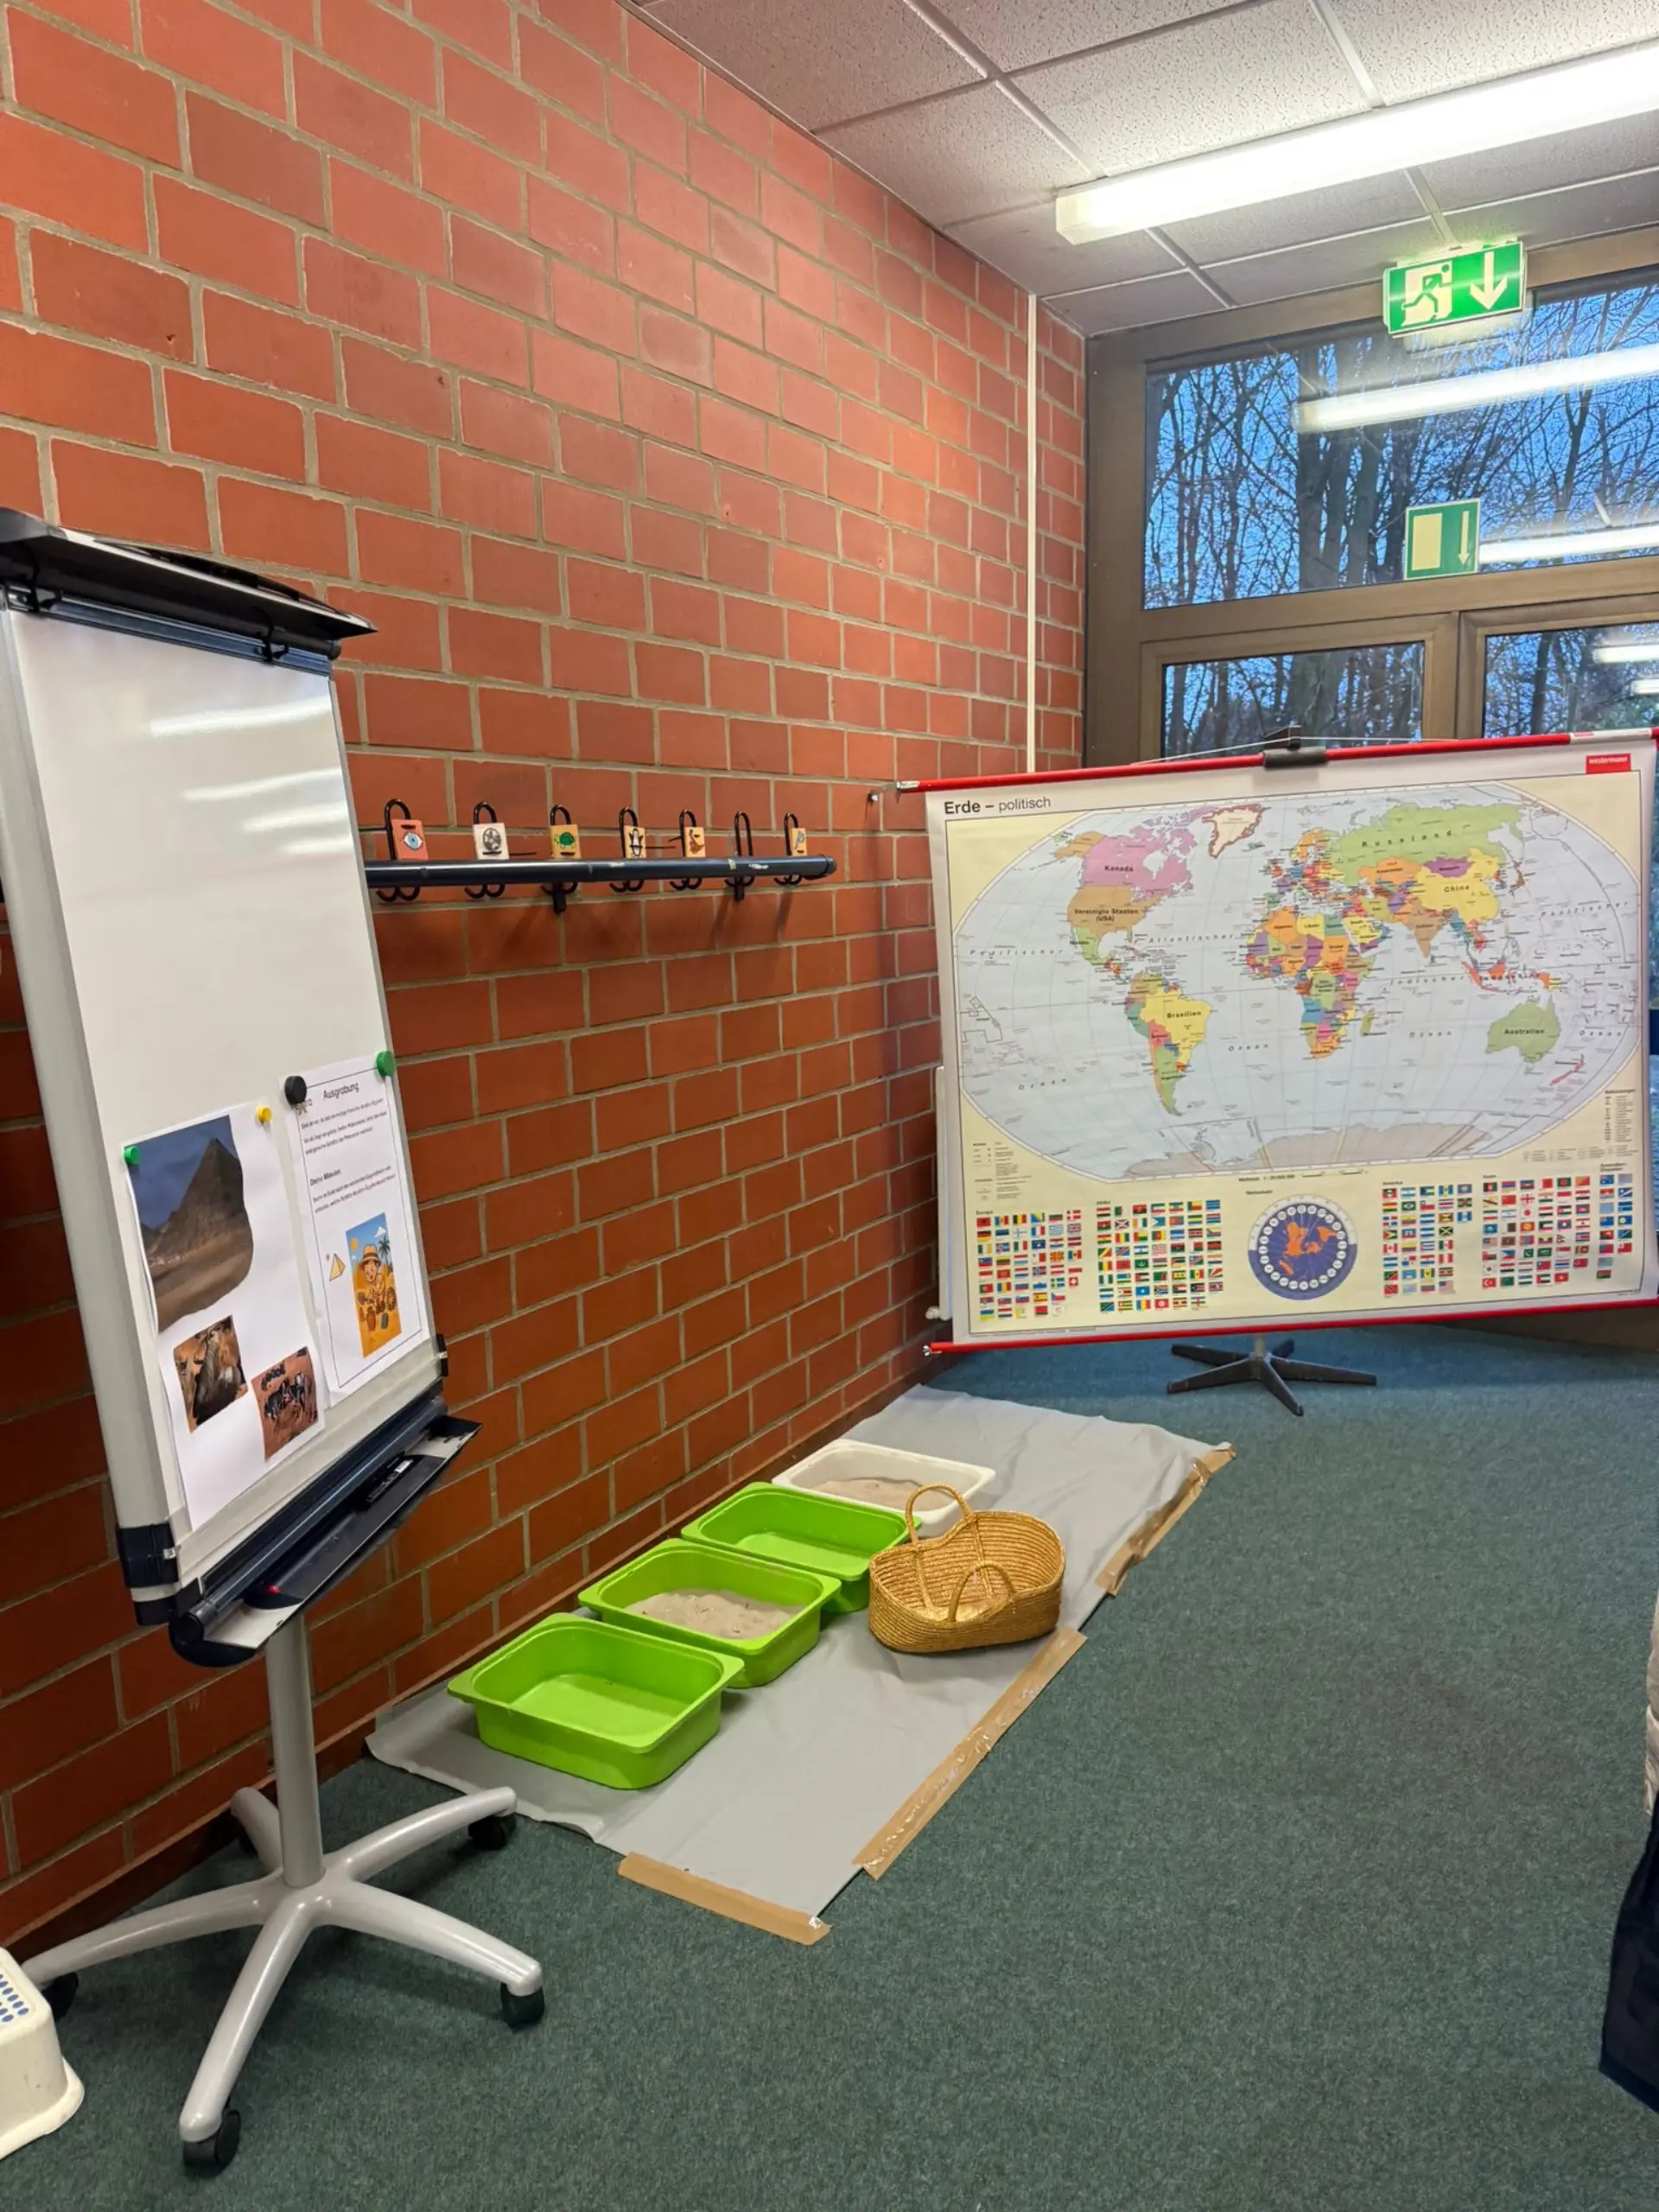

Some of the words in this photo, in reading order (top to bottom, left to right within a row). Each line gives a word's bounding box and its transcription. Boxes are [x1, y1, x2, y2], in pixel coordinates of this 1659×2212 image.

[1588, 756, 1628, 765] westermann
[944, 799, 981, 814] Erde
[998, 796, 1051, 813] politisch
[1166, 1010, 1201, 1019] Brasilien
[323, 1083, 359, 1100] Ausgrabung
